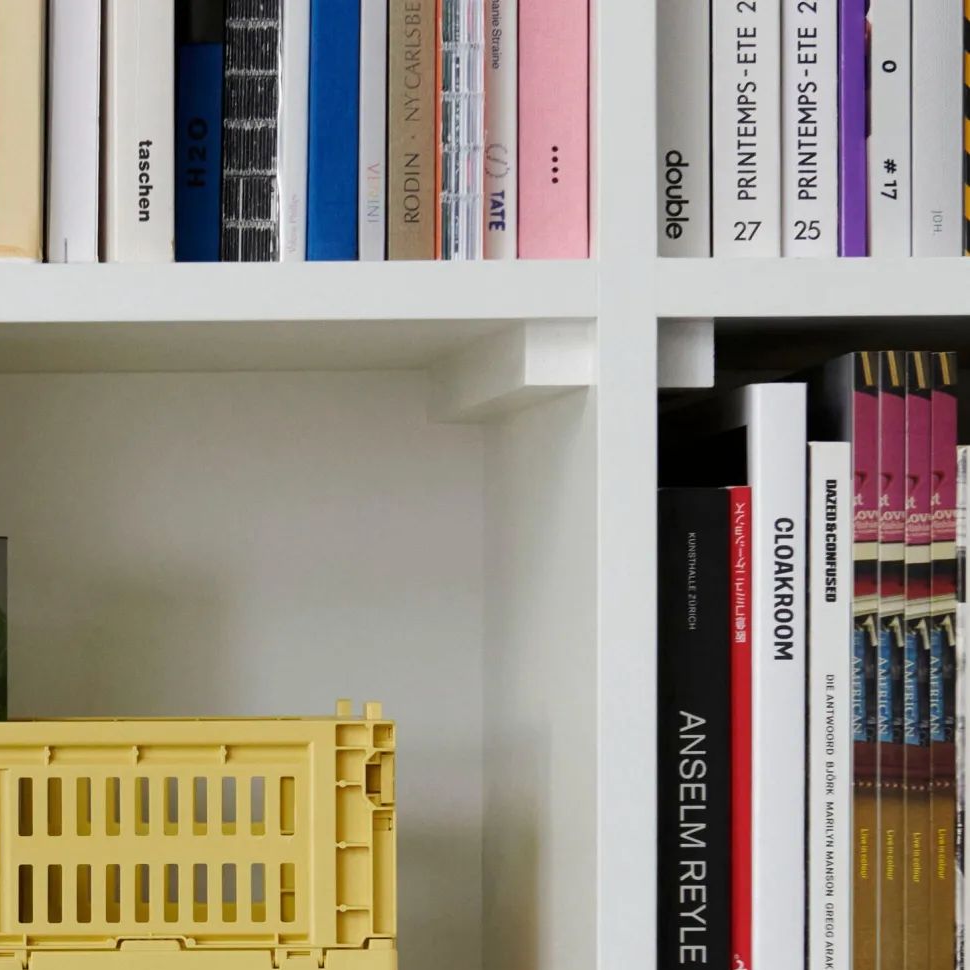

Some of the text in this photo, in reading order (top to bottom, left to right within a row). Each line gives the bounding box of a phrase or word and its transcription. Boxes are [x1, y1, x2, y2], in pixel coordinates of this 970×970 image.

[491, 28, 503, 69] Straine
[737, 27, 756, 64] ETE
[798, 27, 817, 64] ETE
[737, 82, 756, 199] PRINTEMPS
[798, 82, 817, 199] PRINTEMPS
[138, 140, 153, 222] taschen
[404, 153, 421, 223] RODIN
[489, 190, 506, 231] TATE
[666, 150, 689, 239] double
[733, 221, 762, 241] 27
[794, 220, 821, 241] 25
[688, 533, 696, 590] KUNSTHALLE
[773, 517, 795, 661] CLOAKROOM
[825, 674, 834, 691] DIE
[852, 656, 863, 735] AMERICAN
[878, 656, 888, 735] AMERICAN
[904, 659, 915, 737] AMERICAN
[930, 656, 940, 734] AMERICAN
[825, 694, 834, 755] ANTWOORD
[678, 710, 706, 848] ANSELM
[825, 761, 836, 795] BJÖRK
[825, 801, 834, 847] MARILYN
[825, 851, 834, 896] MANSON
[678, 861, 707, 963] REYLE
[825, 903, 834, 937] GREGG
